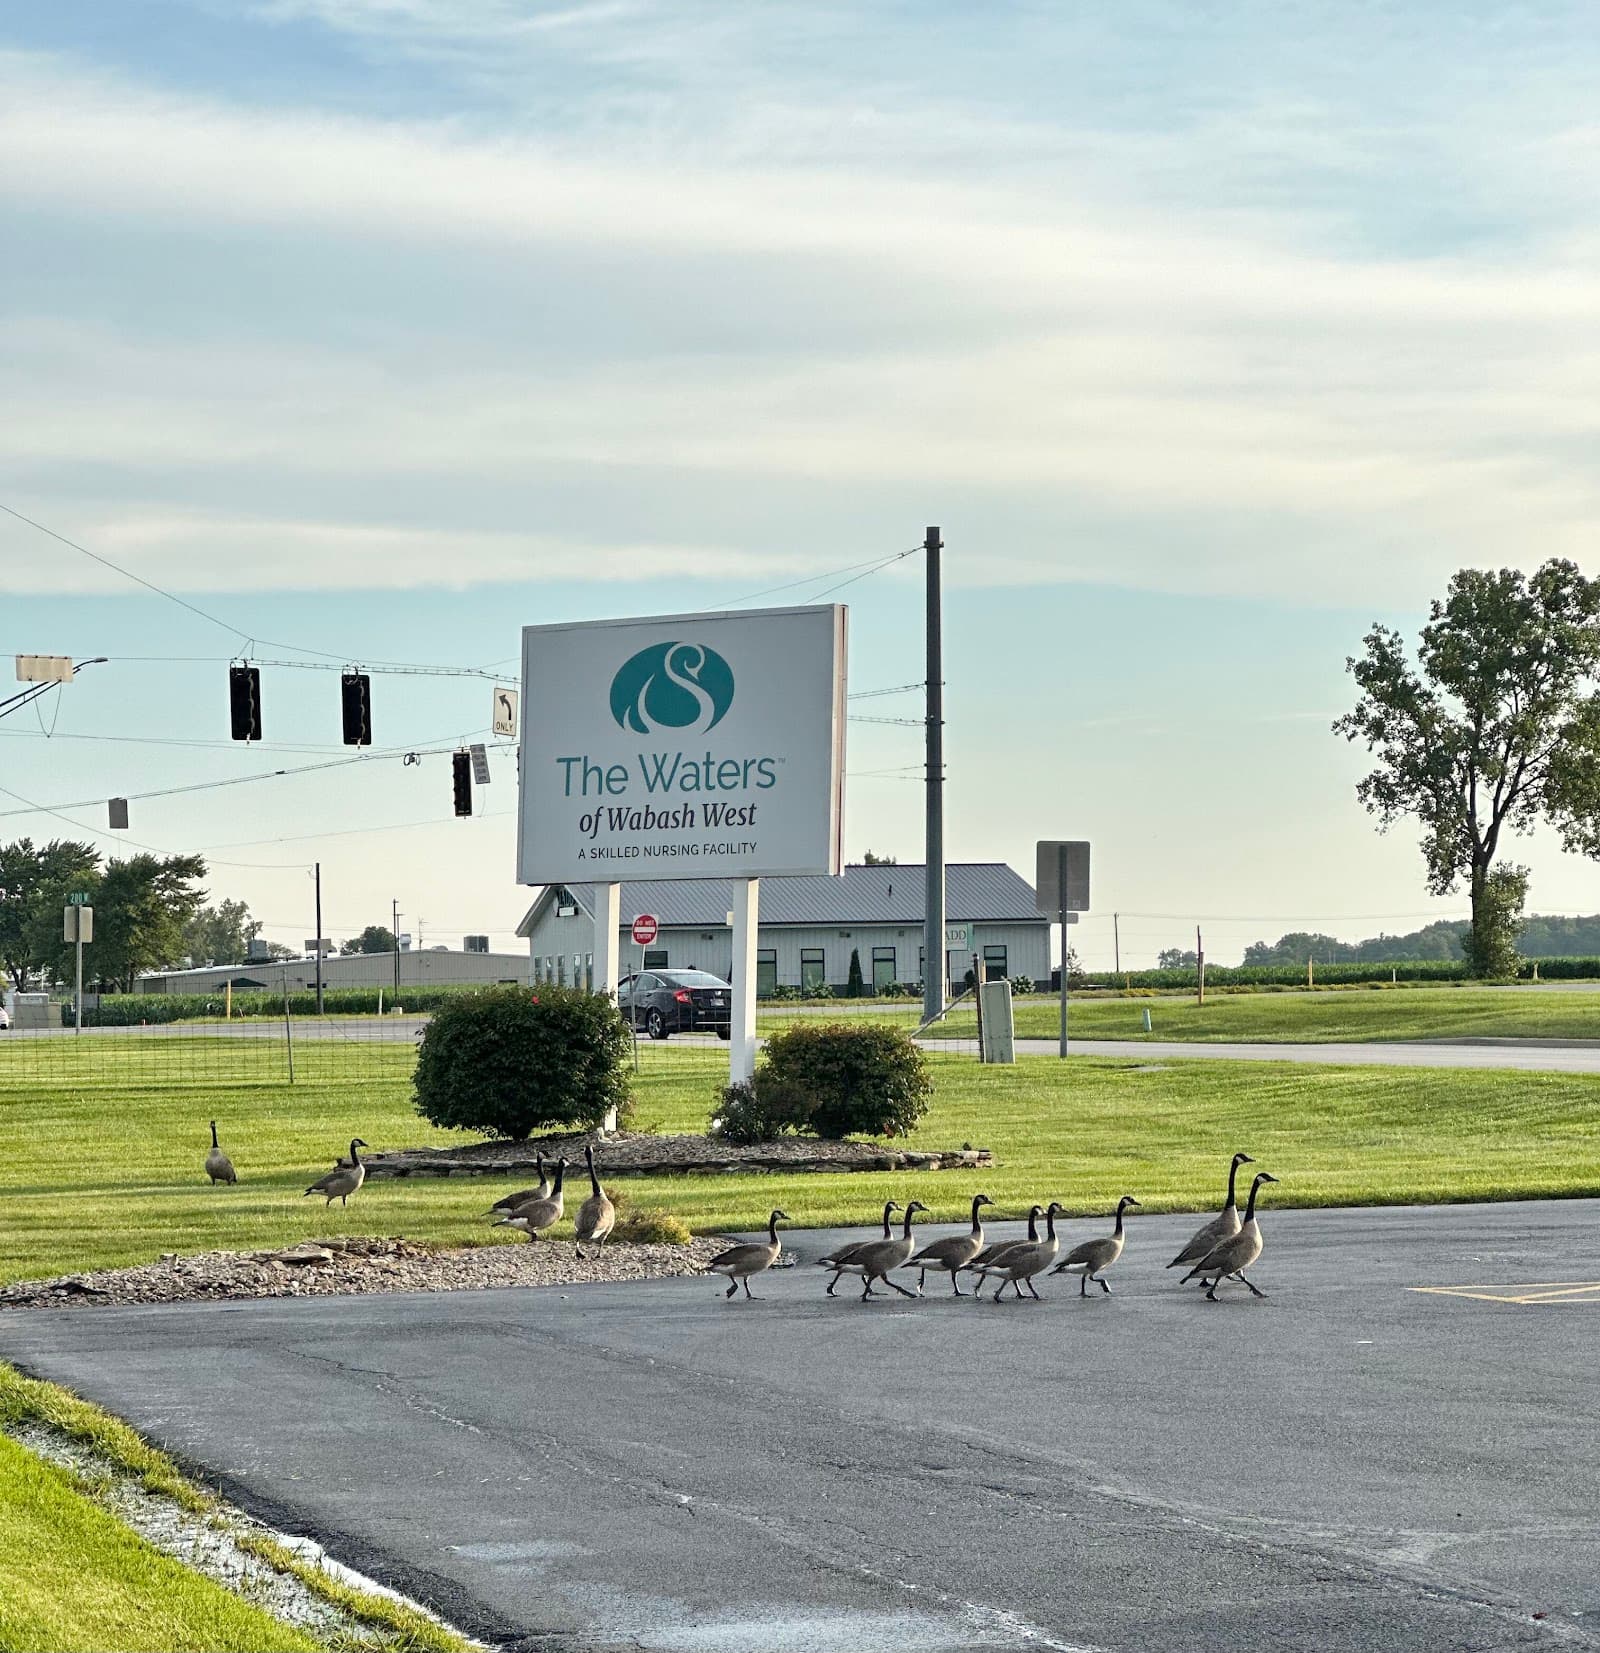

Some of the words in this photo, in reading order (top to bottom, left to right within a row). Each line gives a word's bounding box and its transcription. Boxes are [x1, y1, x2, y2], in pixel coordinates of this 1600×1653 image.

[496, 721, 514, 732] ONLY
[556, 755, 629, 797] The
[638, 751, 777, 793] Waters
[579, 806, 604, 840] of
[607, 803, 695, 832] Wabash
[702, 802, 757, 828] West
[578, 848, 586, 859] A
[590, 846, 640, 859] SKILLED
[643, 844, 699, 857] NURSING
[703, 842, 757, 856] FACILITY
